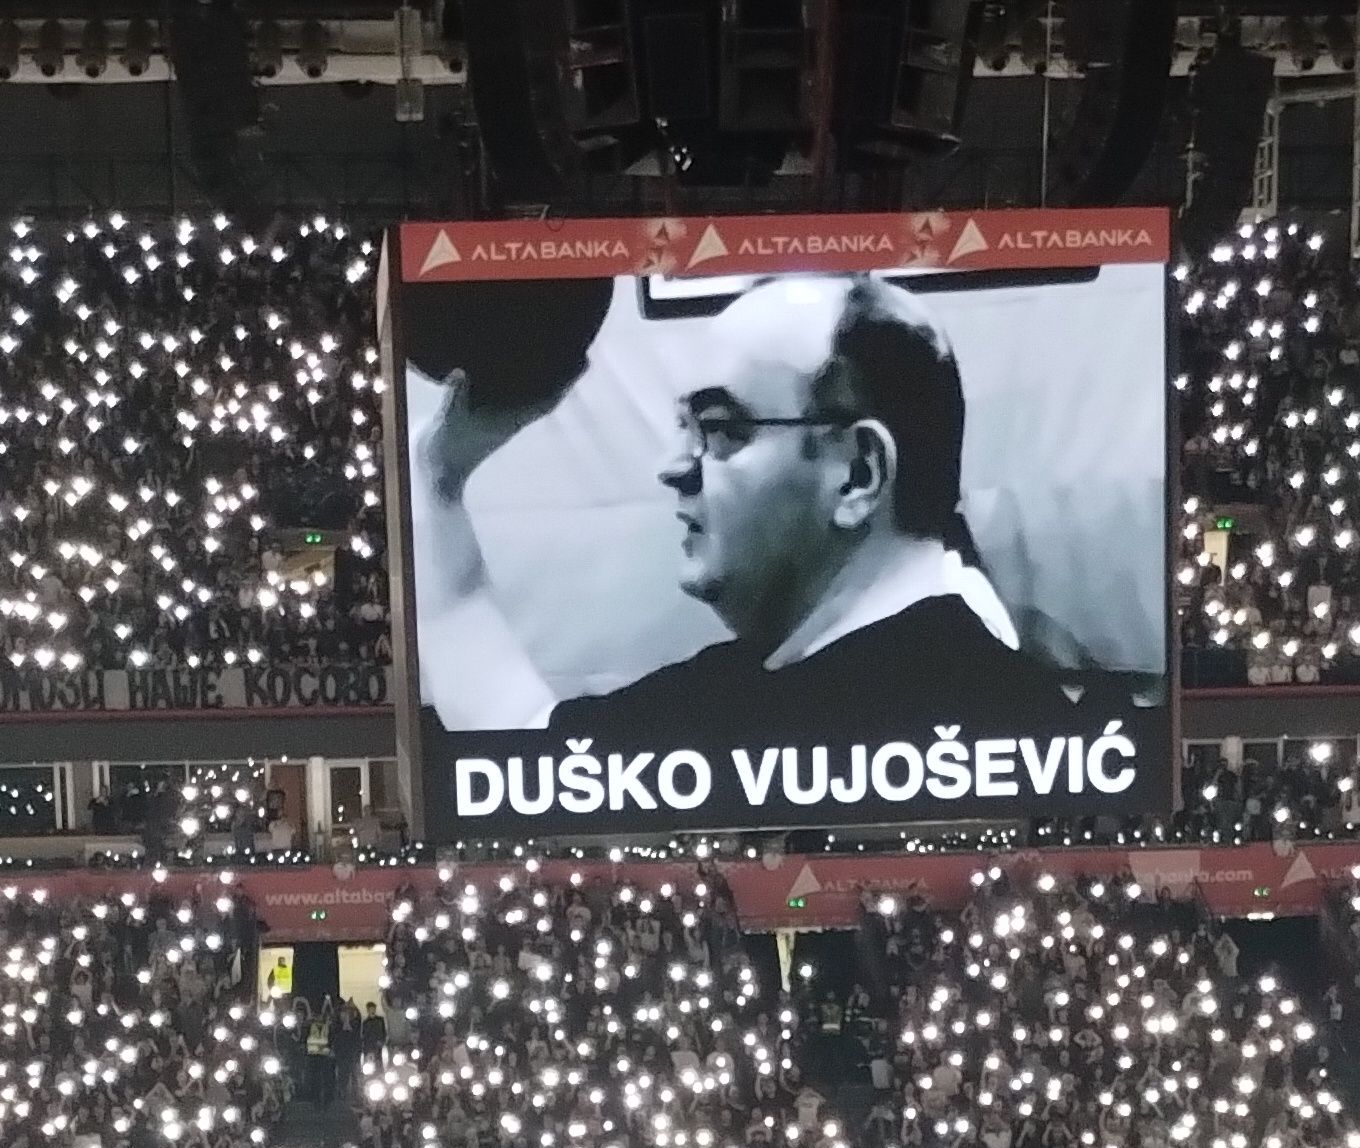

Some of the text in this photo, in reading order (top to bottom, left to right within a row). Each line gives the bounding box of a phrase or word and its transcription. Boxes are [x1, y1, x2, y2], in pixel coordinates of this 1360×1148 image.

[737, 234, 894, 256] ALTABANKA
[997, 227, 1153, 250] ALTABANKA
[471, 240, 630, 261] ALTABANKA
[242, 664, 386, 708] КОСОВО
[455, 719, 1137, 817] DUŠKO VUJOŠEVIĆ
